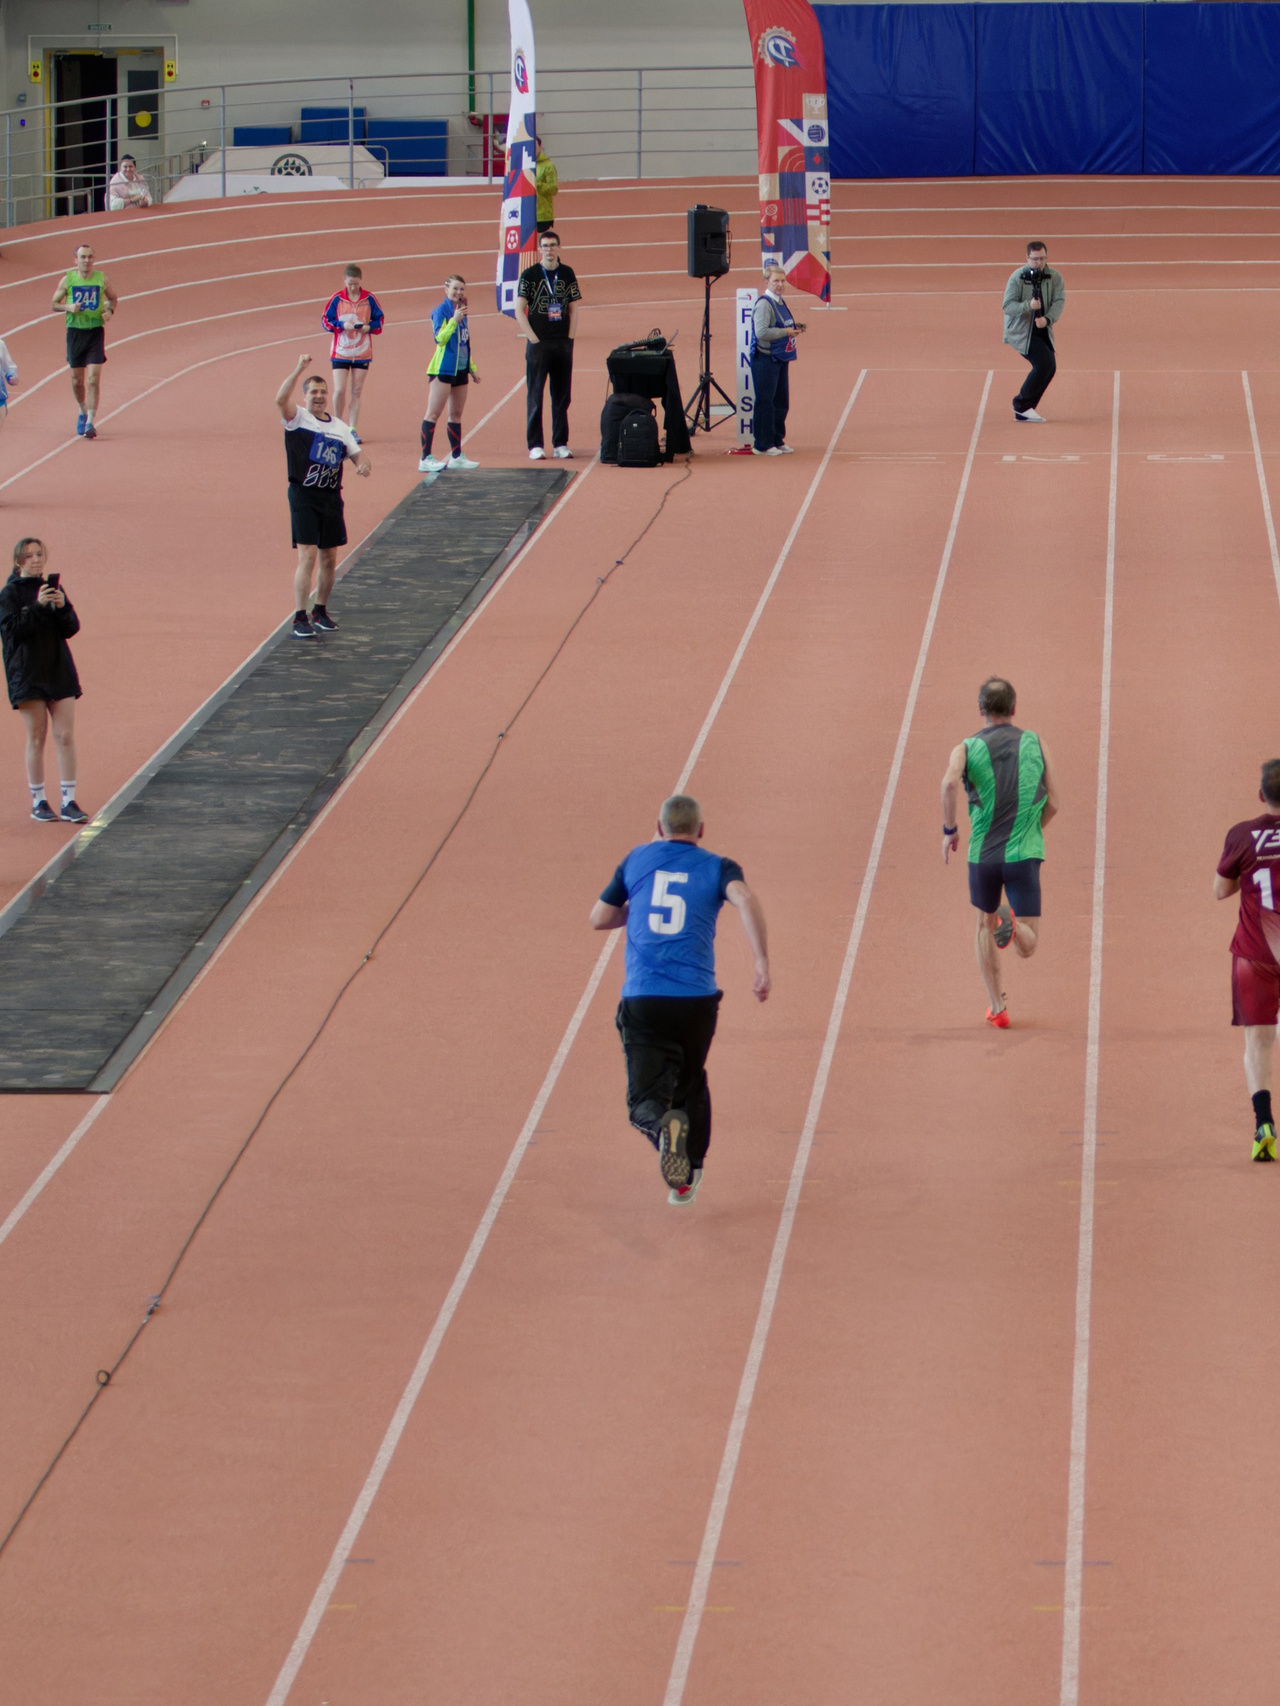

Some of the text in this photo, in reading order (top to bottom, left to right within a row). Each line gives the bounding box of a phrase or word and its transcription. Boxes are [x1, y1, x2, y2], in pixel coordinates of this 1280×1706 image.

[75, 291, 97, 306] 244
[740, 308, 753, 434] FINISH
[316, 441, 337, 464] 146
[648, 870, 689, 935] 5
